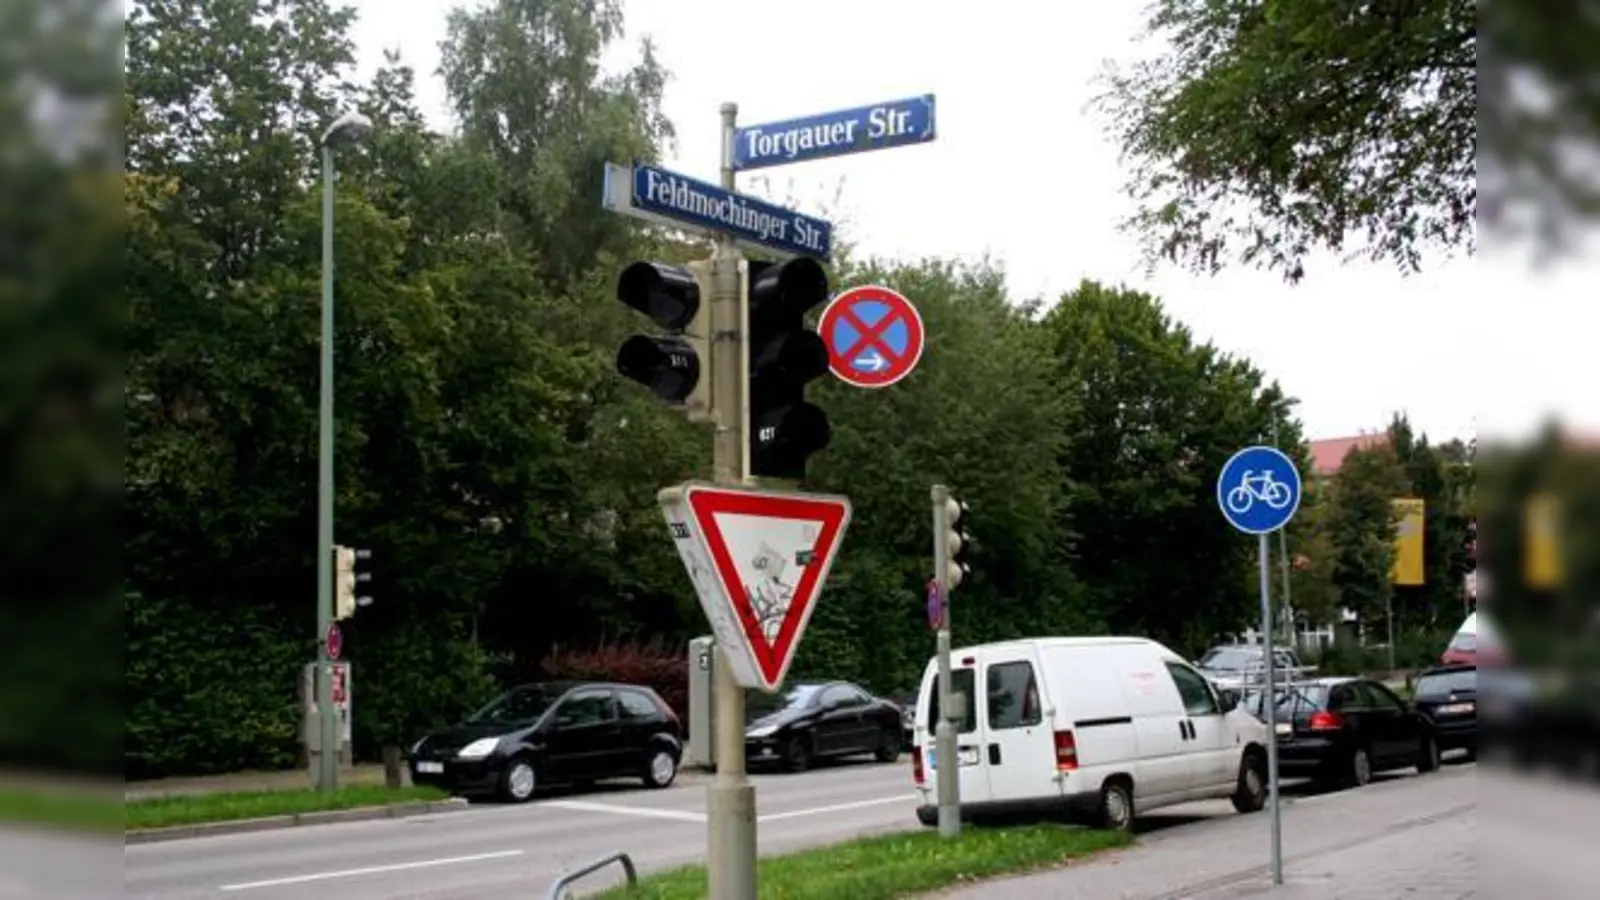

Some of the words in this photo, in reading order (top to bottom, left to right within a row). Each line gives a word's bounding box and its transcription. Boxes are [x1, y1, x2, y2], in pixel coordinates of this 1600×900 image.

[746, 119, 857, 158] Torgauer
[868, 108, 914, 138] Str.
[646, 170, 788, 240] Feldmochinger
[794, 219, 824, 251] Str.
